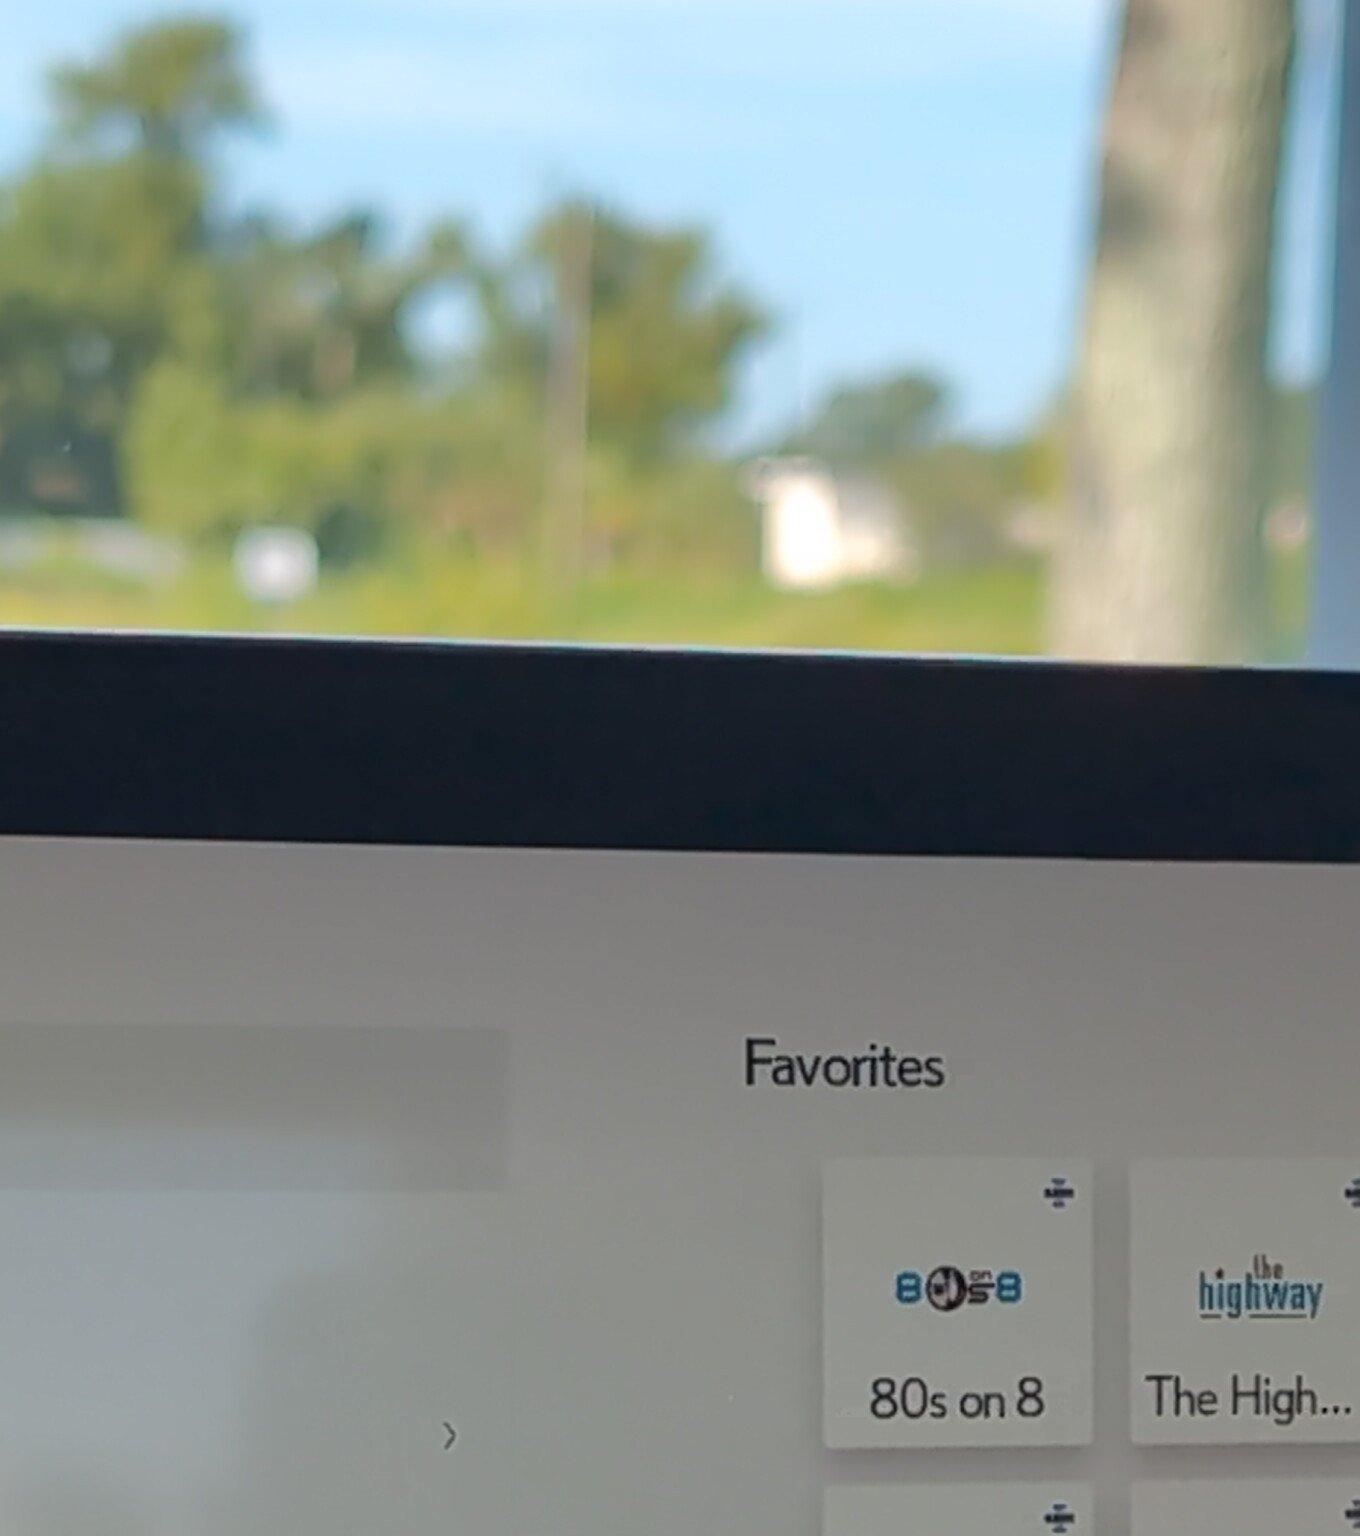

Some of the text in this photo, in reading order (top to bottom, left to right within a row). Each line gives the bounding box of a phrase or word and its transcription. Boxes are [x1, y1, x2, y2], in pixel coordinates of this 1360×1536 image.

[745, 1037, 945, 1088] Favorites
[1253, 1253, 1283, 1279] the
[1199, 1267, 1323, 1319] highway
[870, 1376, 1045, 1420] 80s on 8
[1144, 1373, 1352, 1426] The High...
